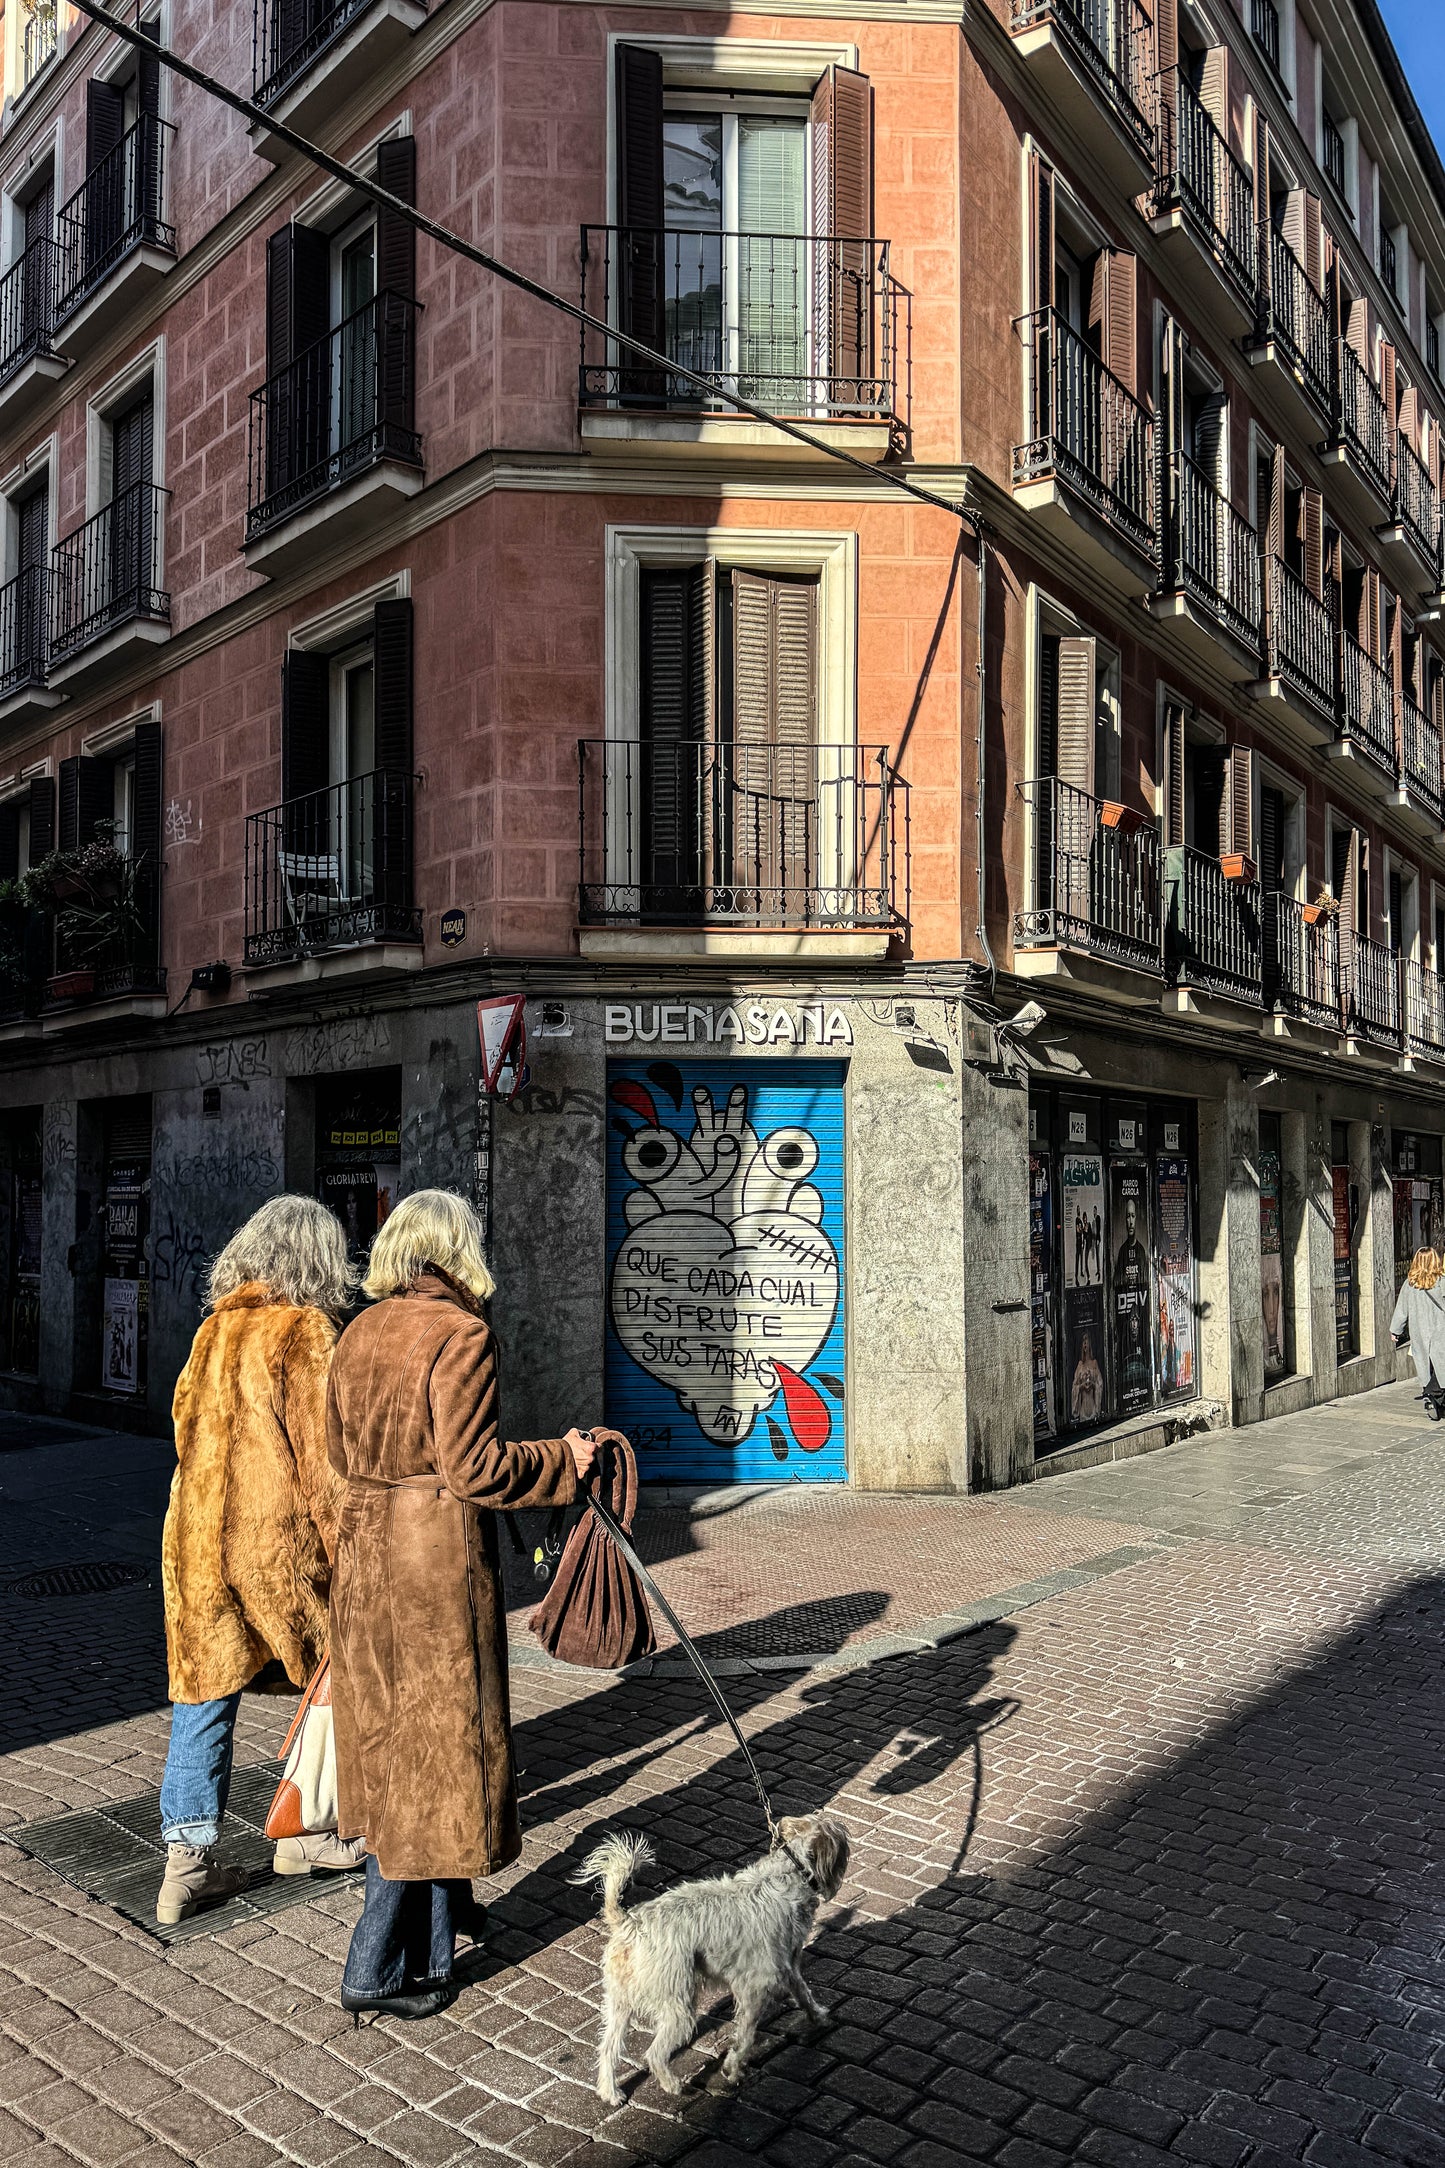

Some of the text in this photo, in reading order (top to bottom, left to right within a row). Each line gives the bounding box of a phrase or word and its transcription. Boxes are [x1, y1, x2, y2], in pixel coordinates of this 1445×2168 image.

[1071, 1121, 1085, 1134] N26
[1121, 1128, 1134, 1140] N26
[1166, 1131, 1177, 1142] N26
[326, 1172, 376, 1186] GLORIA TREVI
[1122, 1179, 1138, 1187] MARCO
[1121, 1187, 1139, 1195] CAROLA
[626, 1246, 823, 1307] QUE CADA CUAL
[642, 1331, 777, 1389] SUS TARAS
